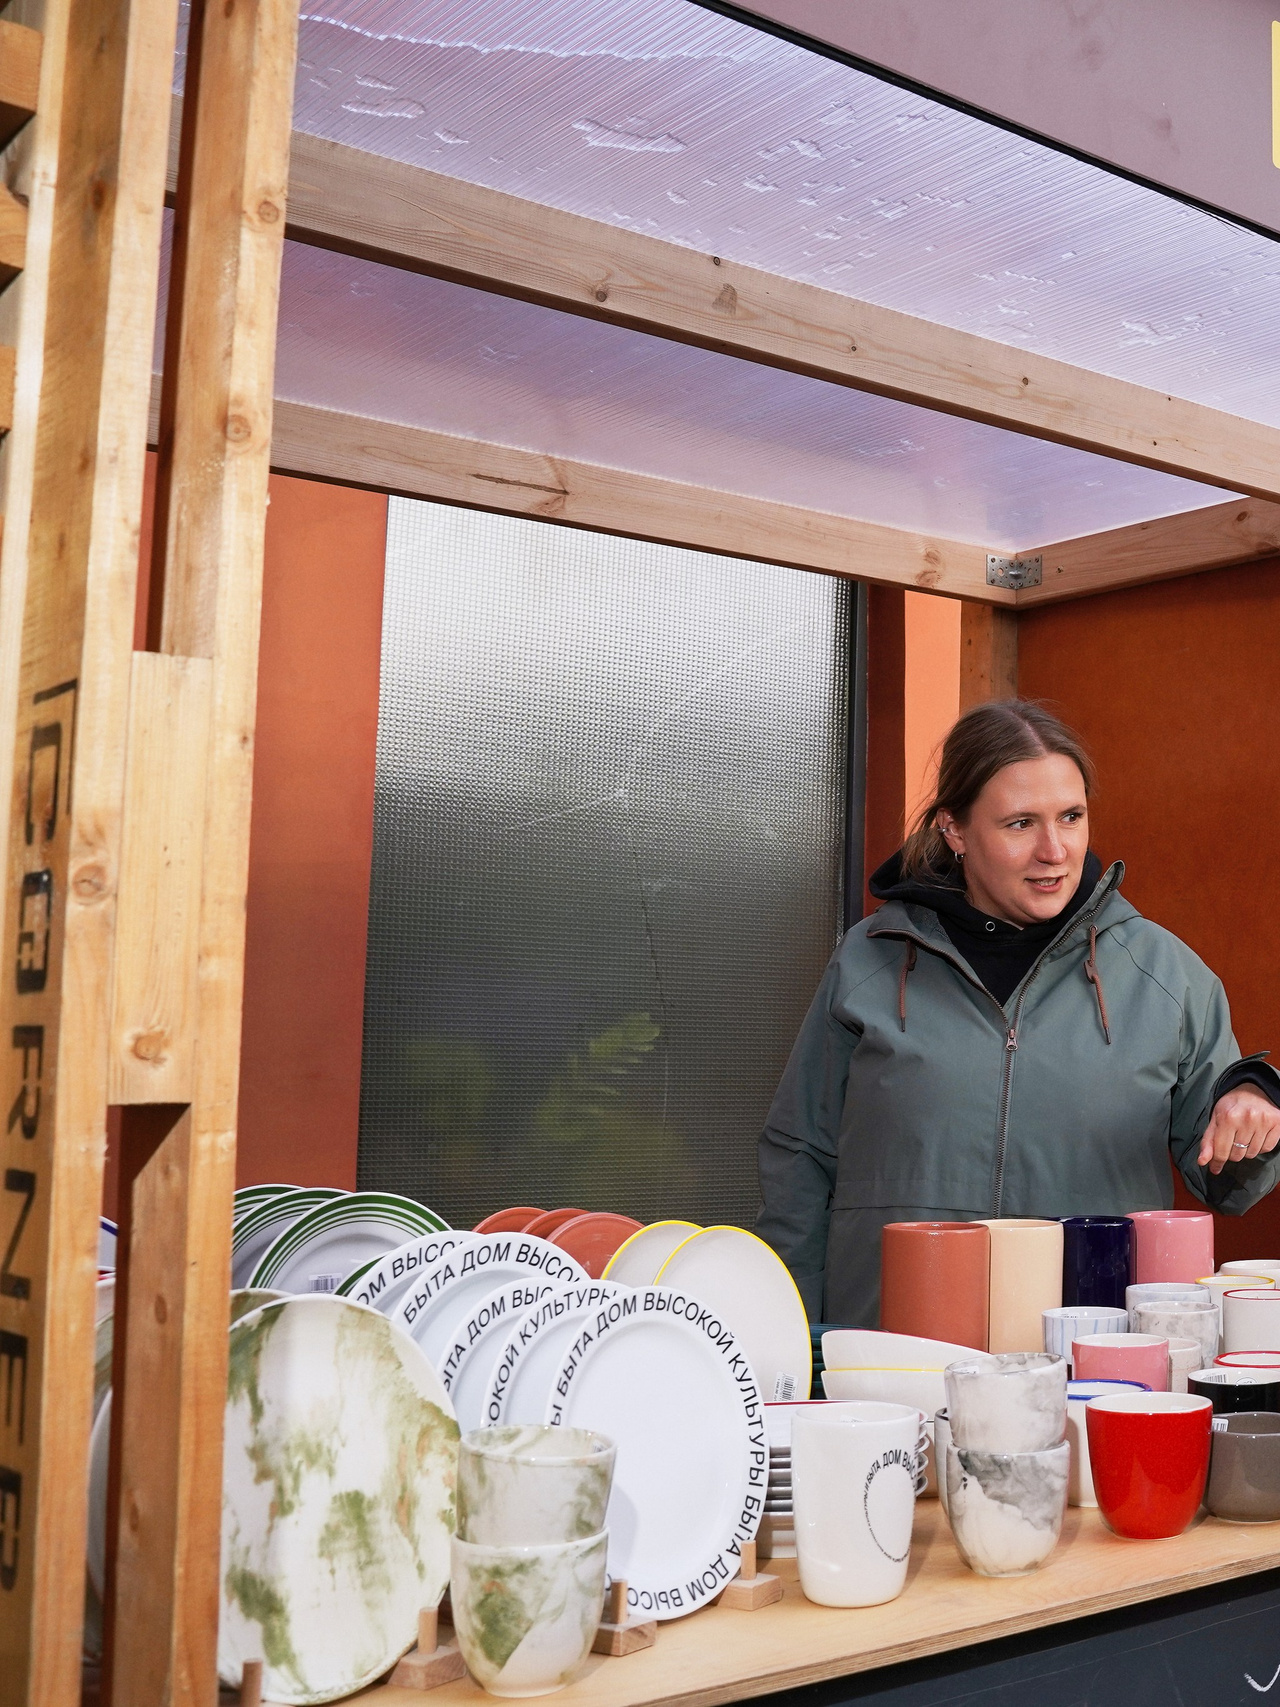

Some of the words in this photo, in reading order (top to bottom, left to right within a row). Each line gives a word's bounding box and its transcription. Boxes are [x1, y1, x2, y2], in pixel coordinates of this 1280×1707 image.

[392, 1240, 463, 1278] ВЫСО
[403, 1264, 455, 1324] БЫТА
[460, 1242, 511, 1276] ДОМ
[516, 1243, 580, 1283] ВЫСО
[467, 1296, 506, 1345] ДОМ
[597, 1295, 637, 1338] ДОМ
[643, 1292, 735, 1354] ВЫСОКОЙ
[488, 1344, 519, 1427] ОКОЙ
[557, 1331, 593, 1397] БЫТА
[728, 1353, 765, 1487] КУЛЬТУРЫ
[882, 1449, 902, 1469] ДОМ
[686, 1554, 729, 1601] ДОМ
